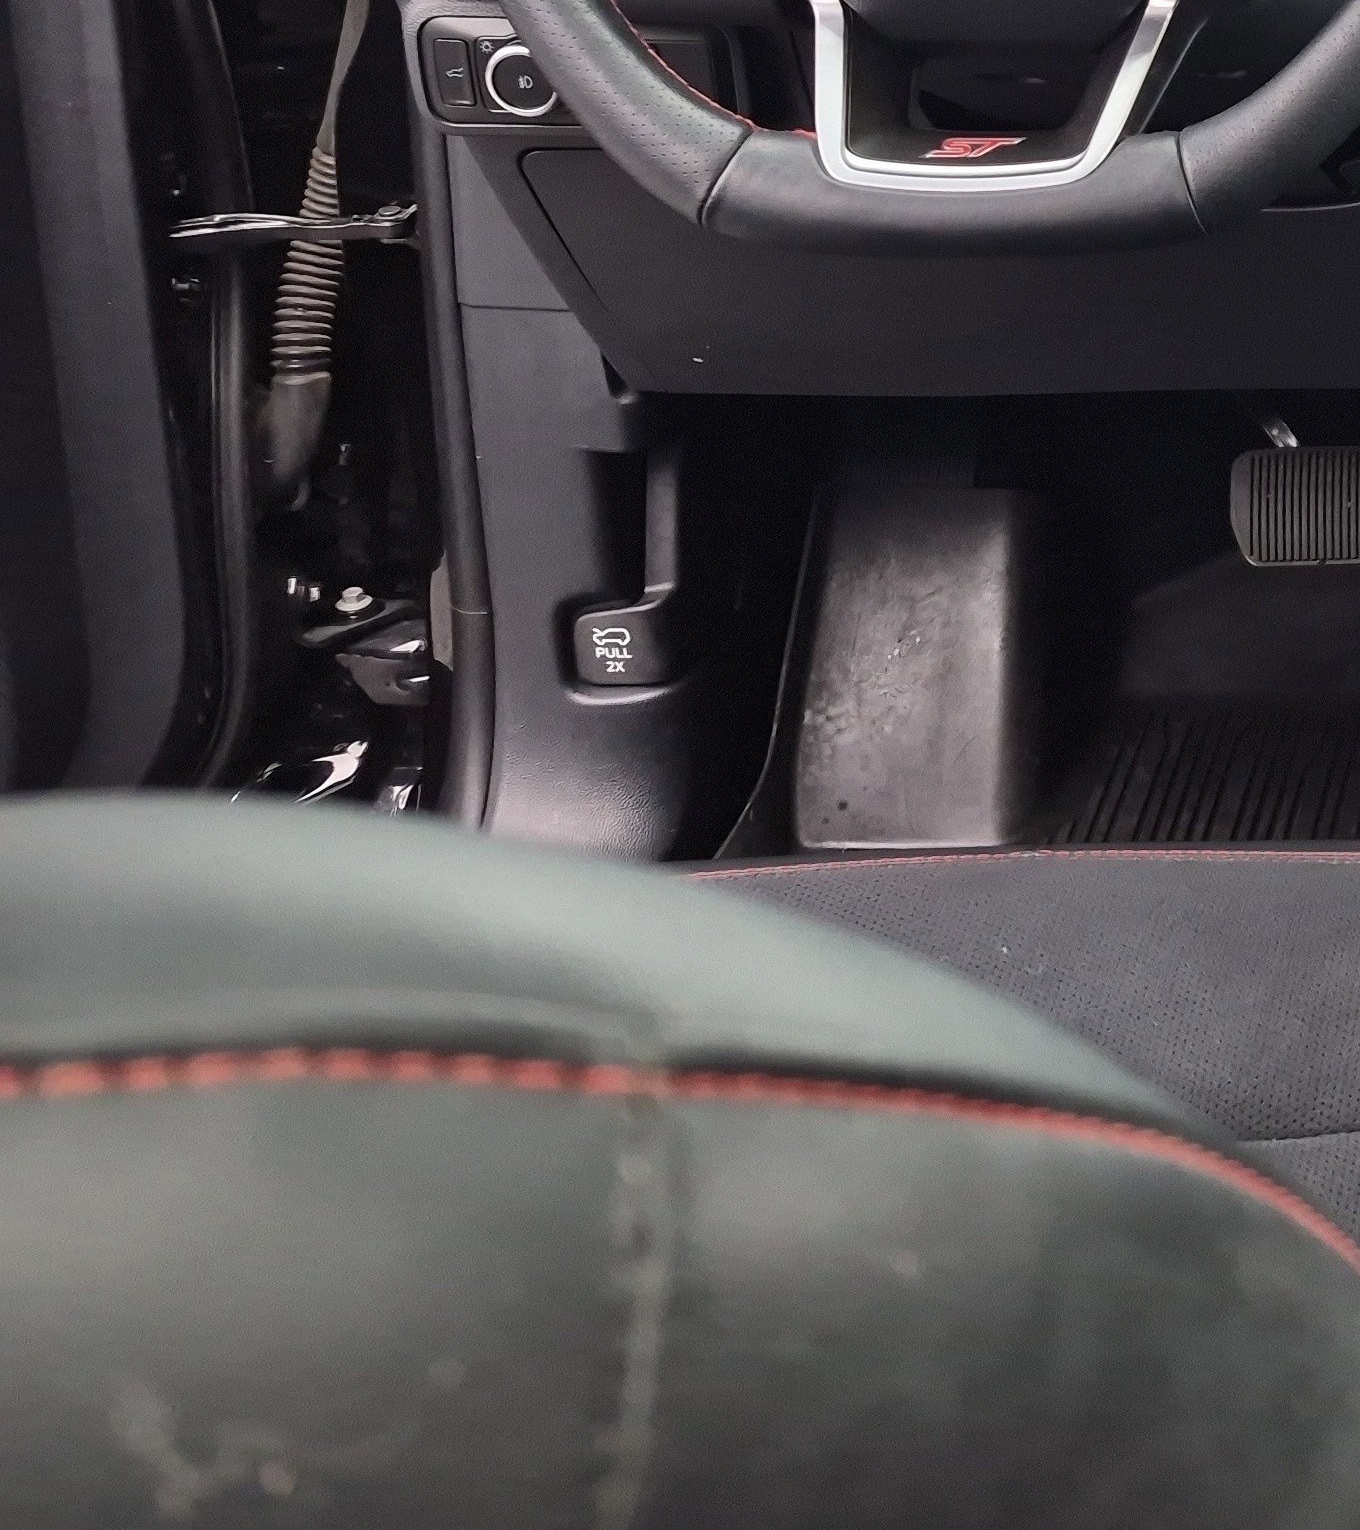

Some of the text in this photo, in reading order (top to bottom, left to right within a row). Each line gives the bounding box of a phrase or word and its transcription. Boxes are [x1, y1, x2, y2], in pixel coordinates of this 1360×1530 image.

[924, 137, 1028, 158] ST
[595, 647, 634, 659] PULL
[605, 661, 626, 673] 2X
